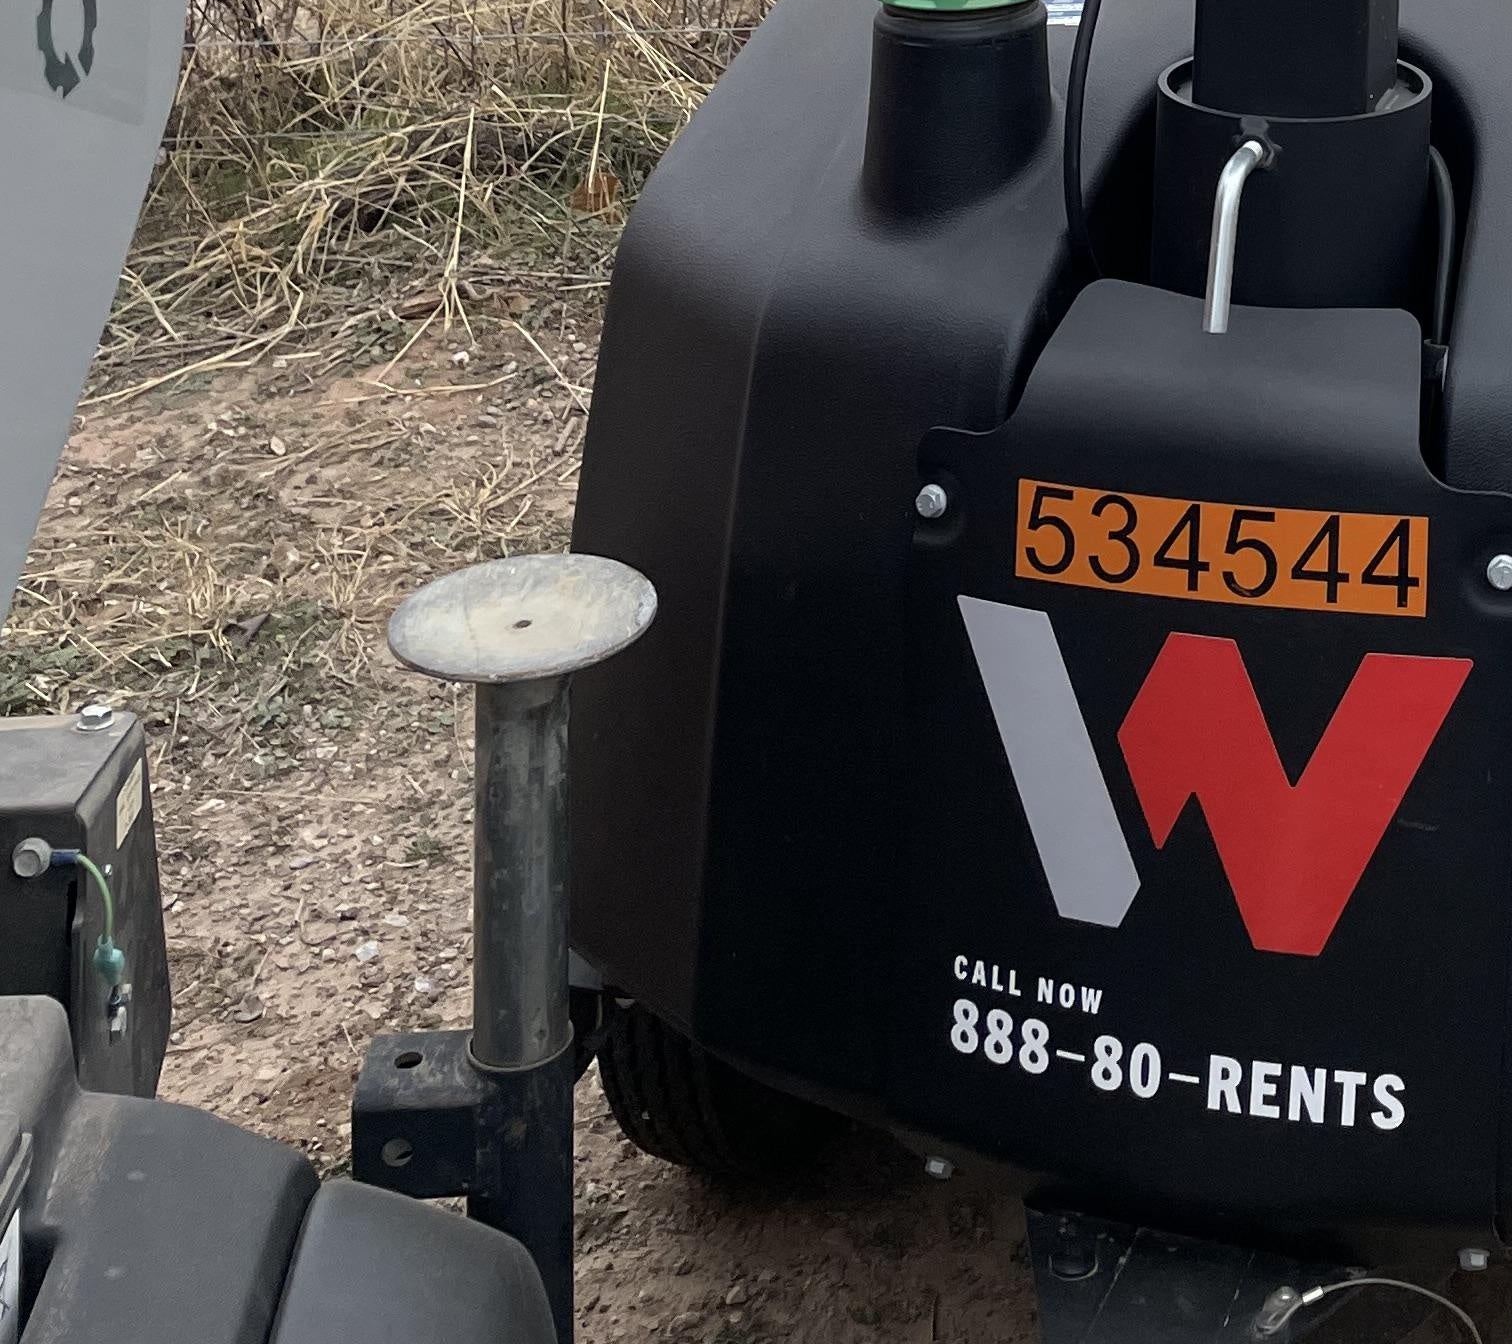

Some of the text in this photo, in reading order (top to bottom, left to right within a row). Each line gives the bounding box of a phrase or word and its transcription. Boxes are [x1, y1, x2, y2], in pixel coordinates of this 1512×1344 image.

[1023, 485, 1420, 609] 534544
[954, 954, 1103, 1014] CALL NOW
[950, 998, 1406, 1130] 888-80-RENTS
